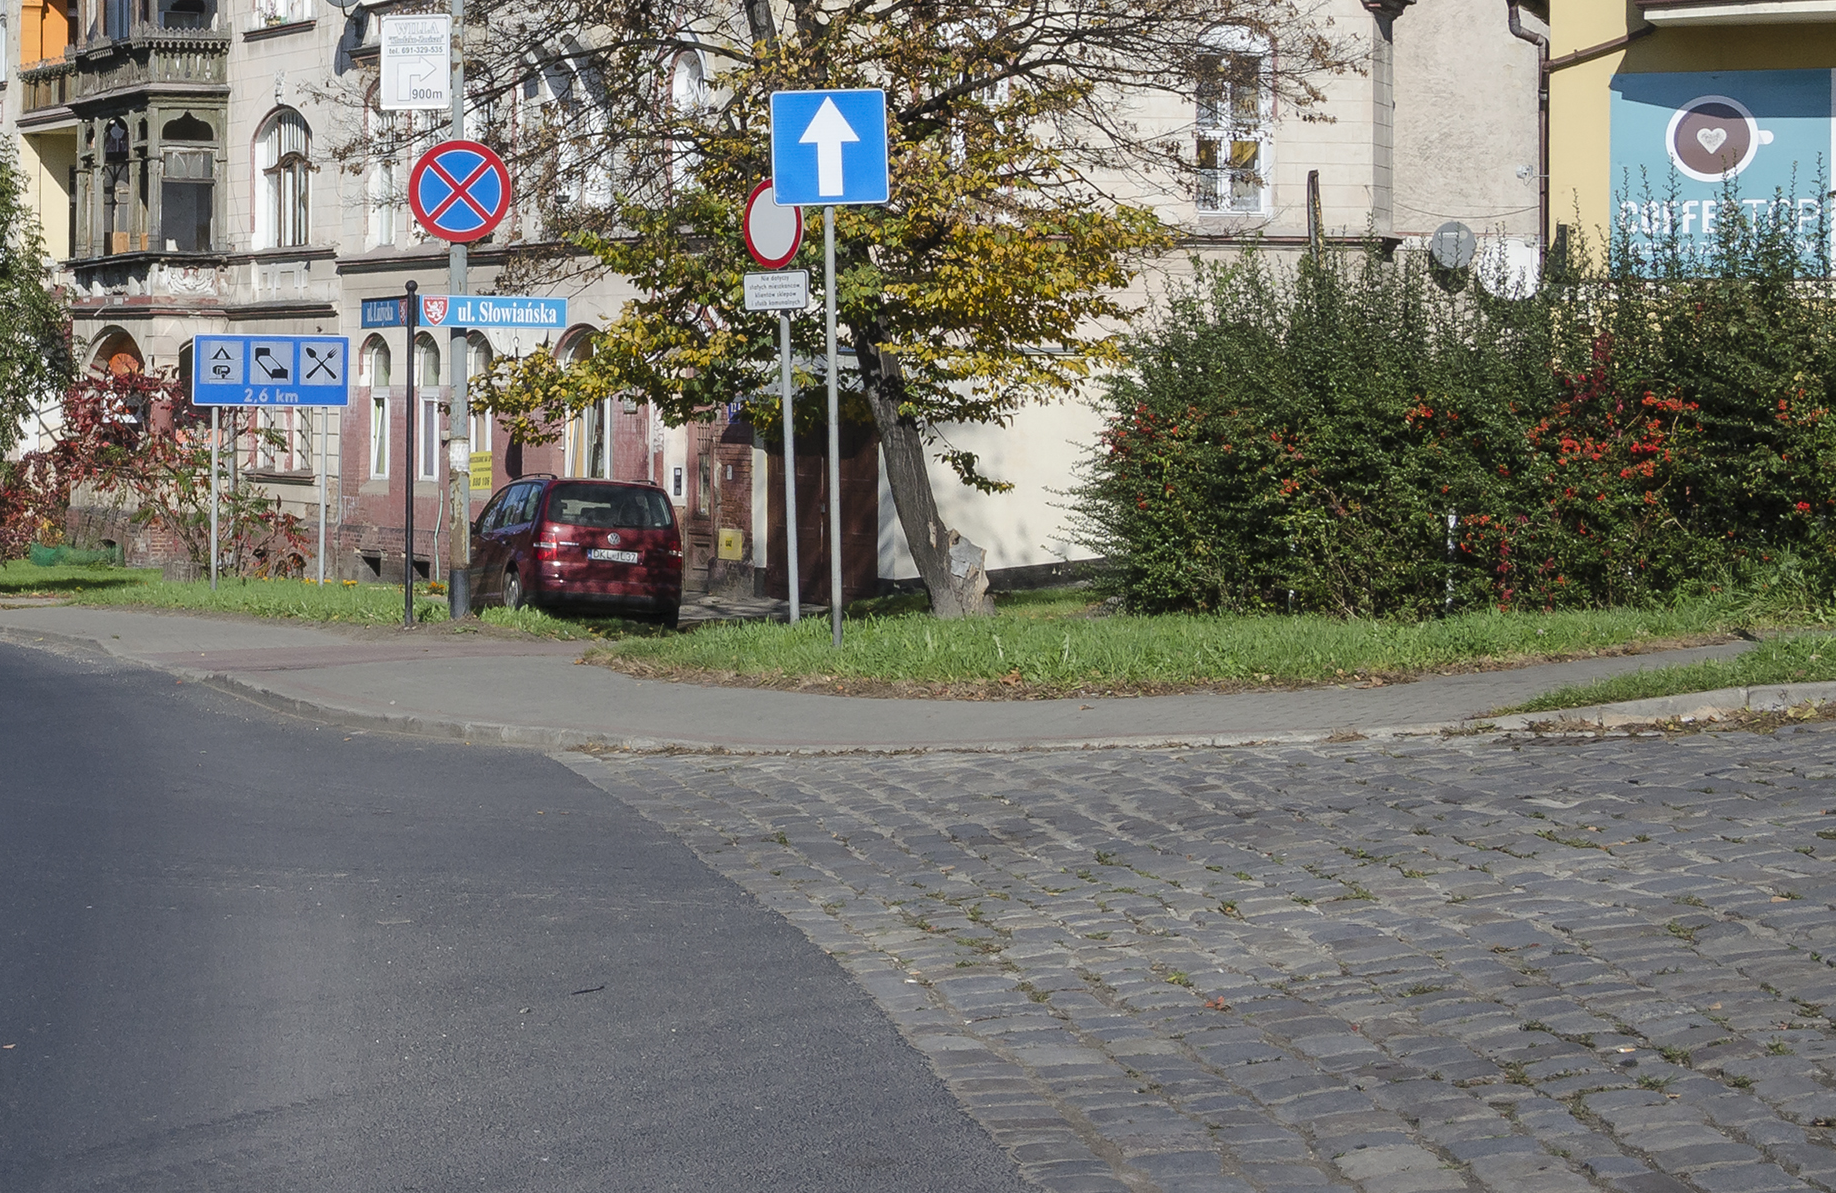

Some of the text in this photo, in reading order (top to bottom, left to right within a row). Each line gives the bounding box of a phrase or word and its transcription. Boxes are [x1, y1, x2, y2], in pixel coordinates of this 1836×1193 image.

[394, 22, 440, 35] WILLA
[402, 46, 443, 54] 691-329-535
[412, 88, 443, 100] 900m
[458, 300, 557, 324] ul. Słowiańska
[244, 388, 299, 404] 2,6 km
[593, 549, 637, 562] DKL JL37
